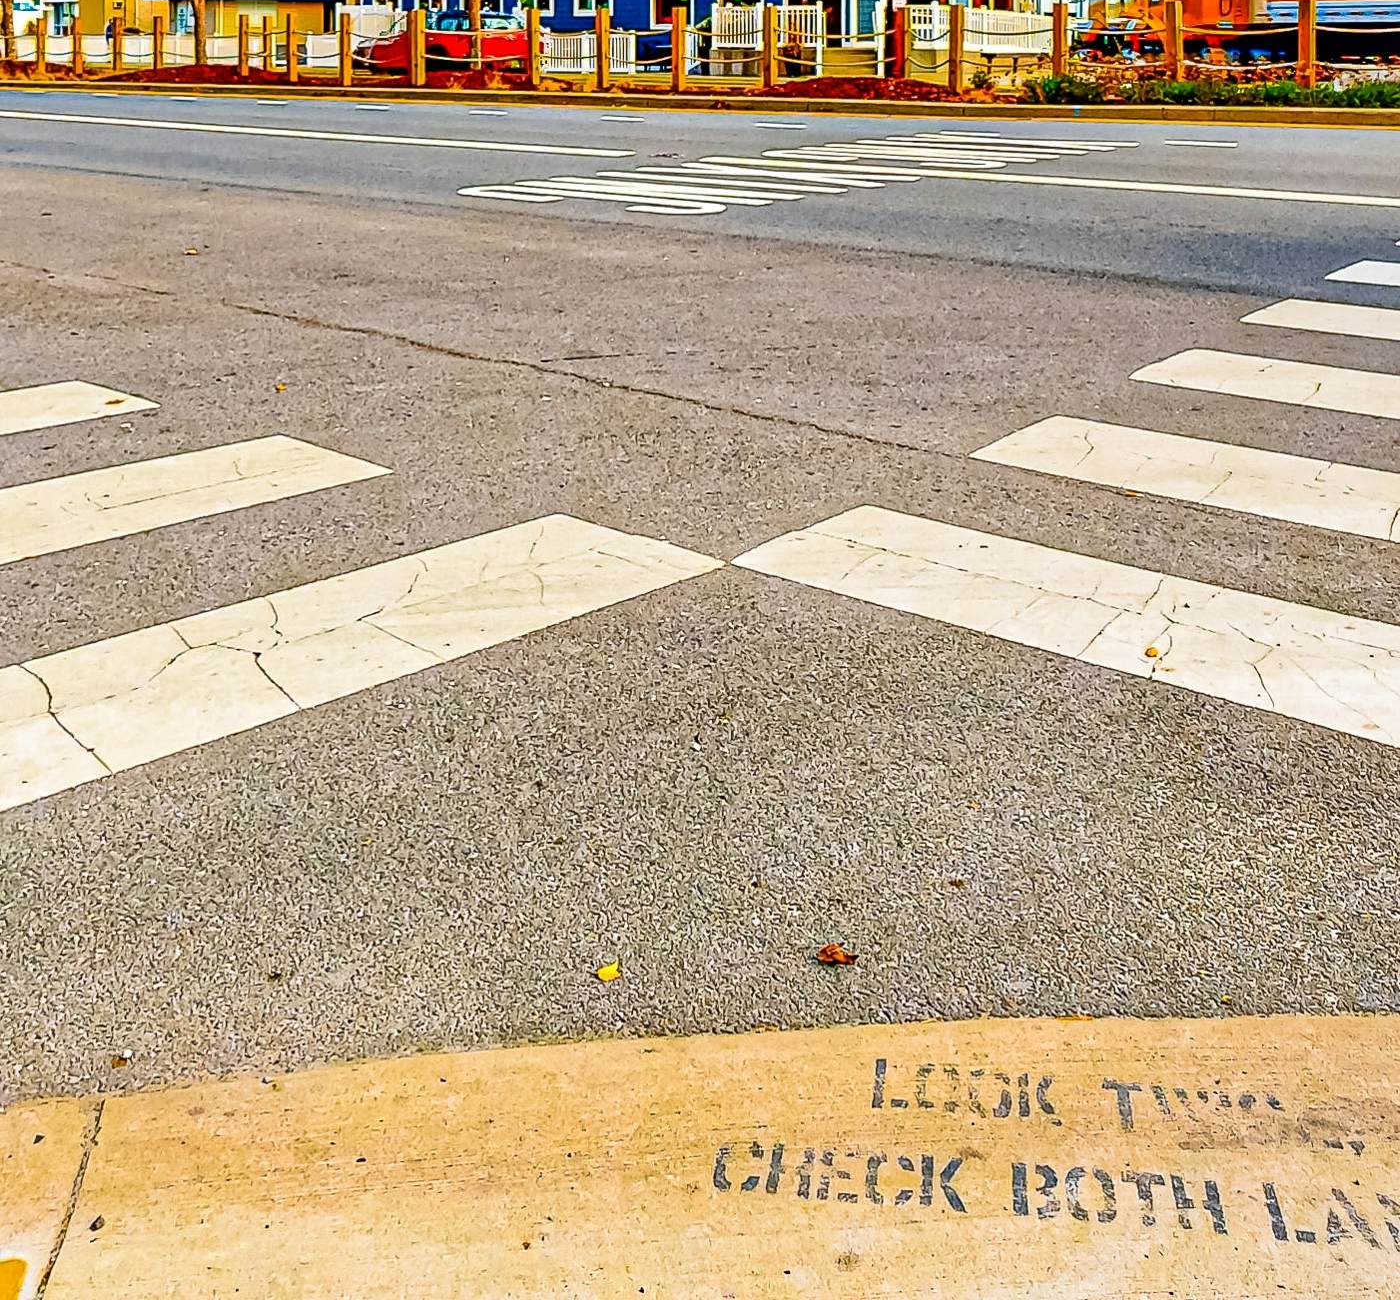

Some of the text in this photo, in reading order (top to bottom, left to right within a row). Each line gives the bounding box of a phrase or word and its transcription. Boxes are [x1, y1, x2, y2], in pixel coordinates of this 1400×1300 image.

[871, 1058, 1063, 1127] LOOK
[713, 1140, 969, 1214] CHECK
[1011, 1161, 1229, 1236] BOTH
